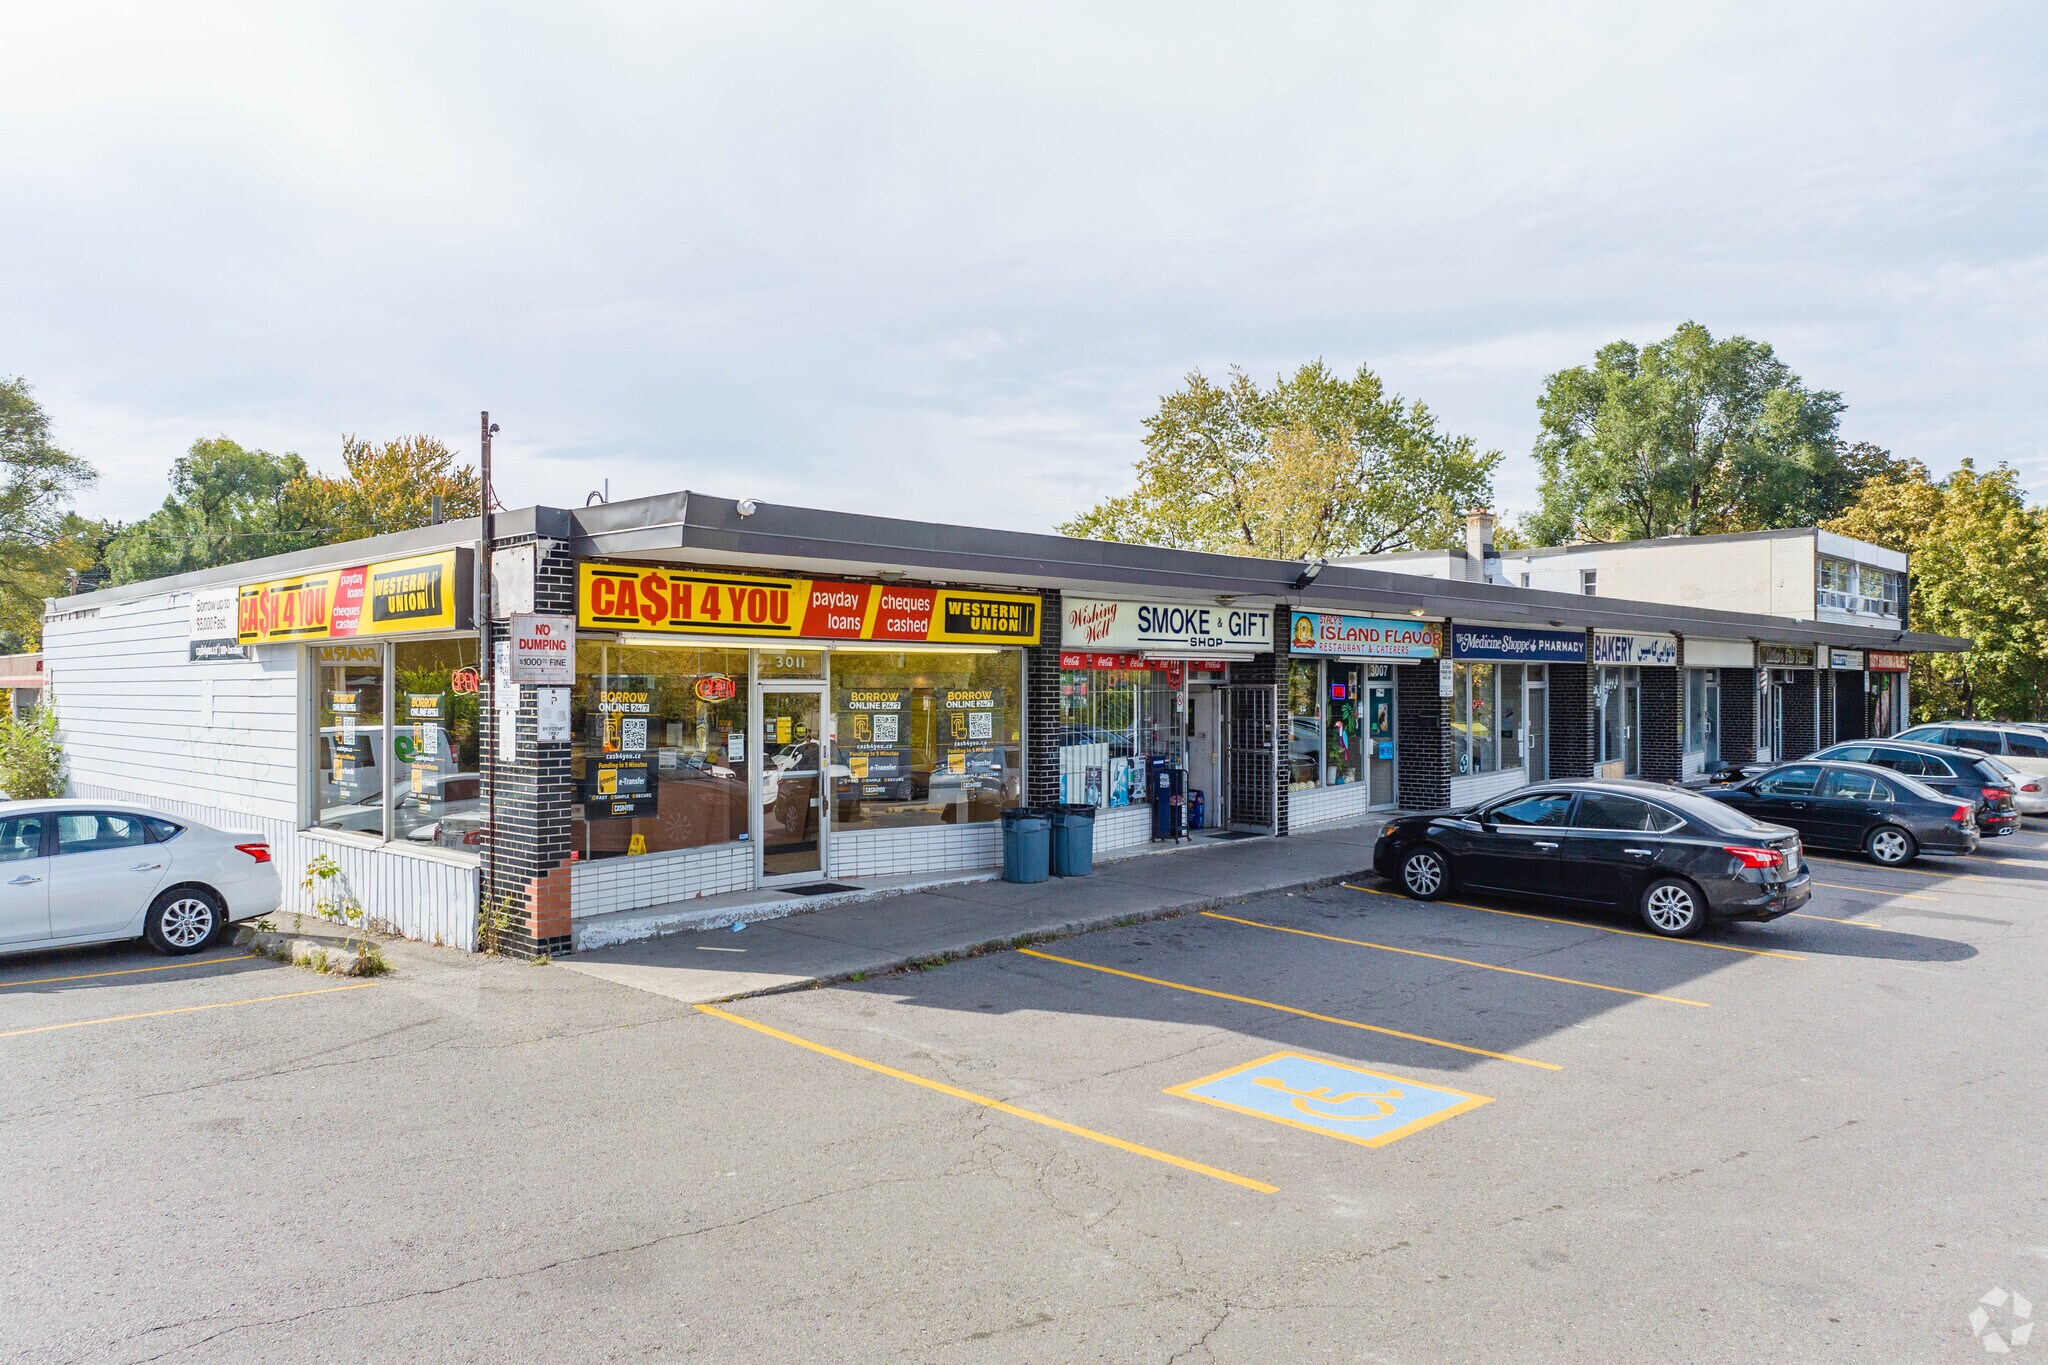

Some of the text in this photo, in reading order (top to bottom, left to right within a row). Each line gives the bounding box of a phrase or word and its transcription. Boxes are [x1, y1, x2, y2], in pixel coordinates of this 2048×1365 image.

[341, 573, 363, 586] payday
[375, 573, 425, 597] WESTERN
[347, 587, 364, 598] loans
[591, 572, 789, 625] CA$H 4 YOU
[197, 599, 215, 612] Borrow
[388, 592, 425, 613] UNION
[812, 591, 859, 611] payday
[881, 596, 930, 615] cheques
[240, 587, 326, 637] CA$H 4 YOU
[333, 606, 360, 618] cheques
[948, 601, 1019, 618] WESTERN
[1069, 602, 1118, 630] Wishing
[335, 618, 359, 630] cashed
[828, 612, 861, 630] loans
[886, 616, 928, 633] cashed
[970, 616, 1019, 632] UNION
[1138, 605, 1270, 637] SMOKE & GIFT
[1319, 614, 1343, 625] STACY'S
[535, 624, 550, 636] NO
[1084, 617, 1111, 645] Well
[1321, 626, 1442, 645] ISLAND FLAVOR
[519, 639, 566, 650] DUMPING
[1190, 637, 1223, 647] SHOP
[1461, 633, 1501, 652] Medicine
[1502, 635, 1530, 653] Shoppe
[1539, 640, 1584, 652] PHARMACY
[1595, 635, 1633, 662] BAKERY
[1319, 643, 1365, 653] RESTAURANT
[1368, 645, 1373, 653] &
[1377, 646, 1409, 655] CATERERS
[550, 658, 566, 666] FINE
[776, 656, 805, 668] 3011
[1370, 665, 1388, 677] 3007
[452, 672, 479, 692] OPEN
[700, 678, 736, 698] OPEN
[411, 697, 438, 707] BORROW
[600, 691, 648, 703] BORROW
[851, 692, 899, 701] BORROW
[947, 691, 992, 700] BORROW
[598, 702, 630, 712] ONLINE
[619, 777, 645, 785] e-Transfer
